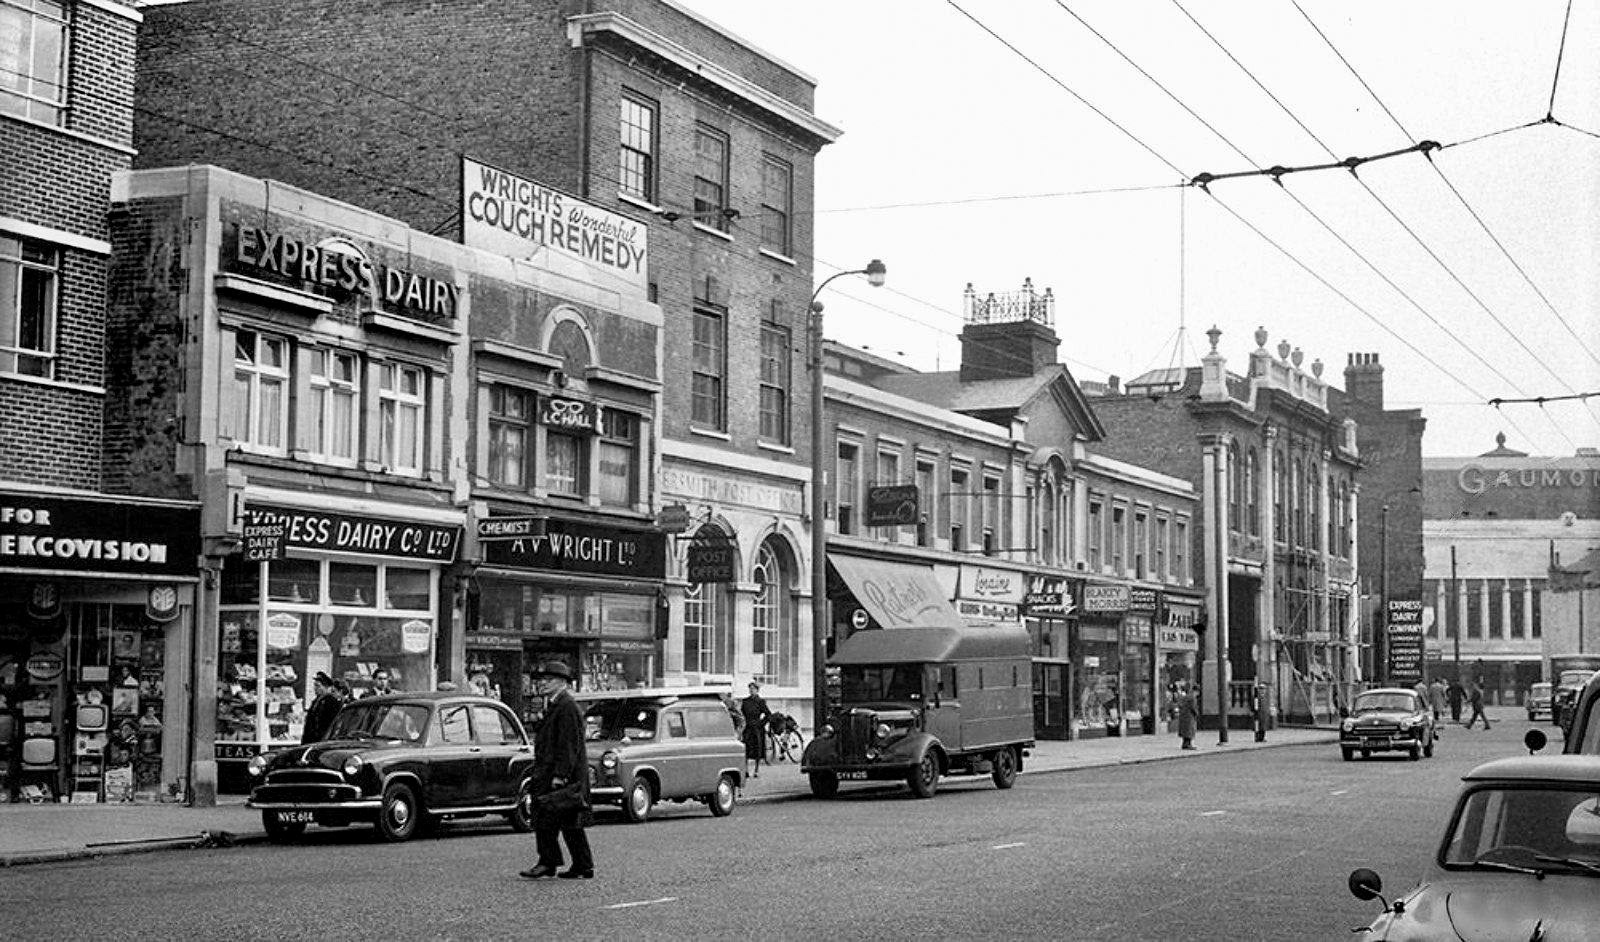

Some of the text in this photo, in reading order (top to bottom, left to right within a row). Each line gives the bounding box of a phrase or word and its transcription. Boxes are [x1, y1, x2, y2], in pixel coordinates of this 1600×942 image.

[468, 191, 645, 274] COUGH REMEDY
[568, 206, 637, 244] Wonderful
[234, 224, 465, 316] EXPRESS DAIRY
[0, 507, 50, 526] FOR
[478, 521, 531, 535] CHEMIST
[244, 525, 284, 538] EXPRESS
[249, 537, 279, 549] DAIRY
[336, 521, 396, 550] DAIRY
[0, 534, 167, 563] EKCOVISION
[549, 532, 612, 563] WRIGHT
[216, 746, 254, 758] TEAS
